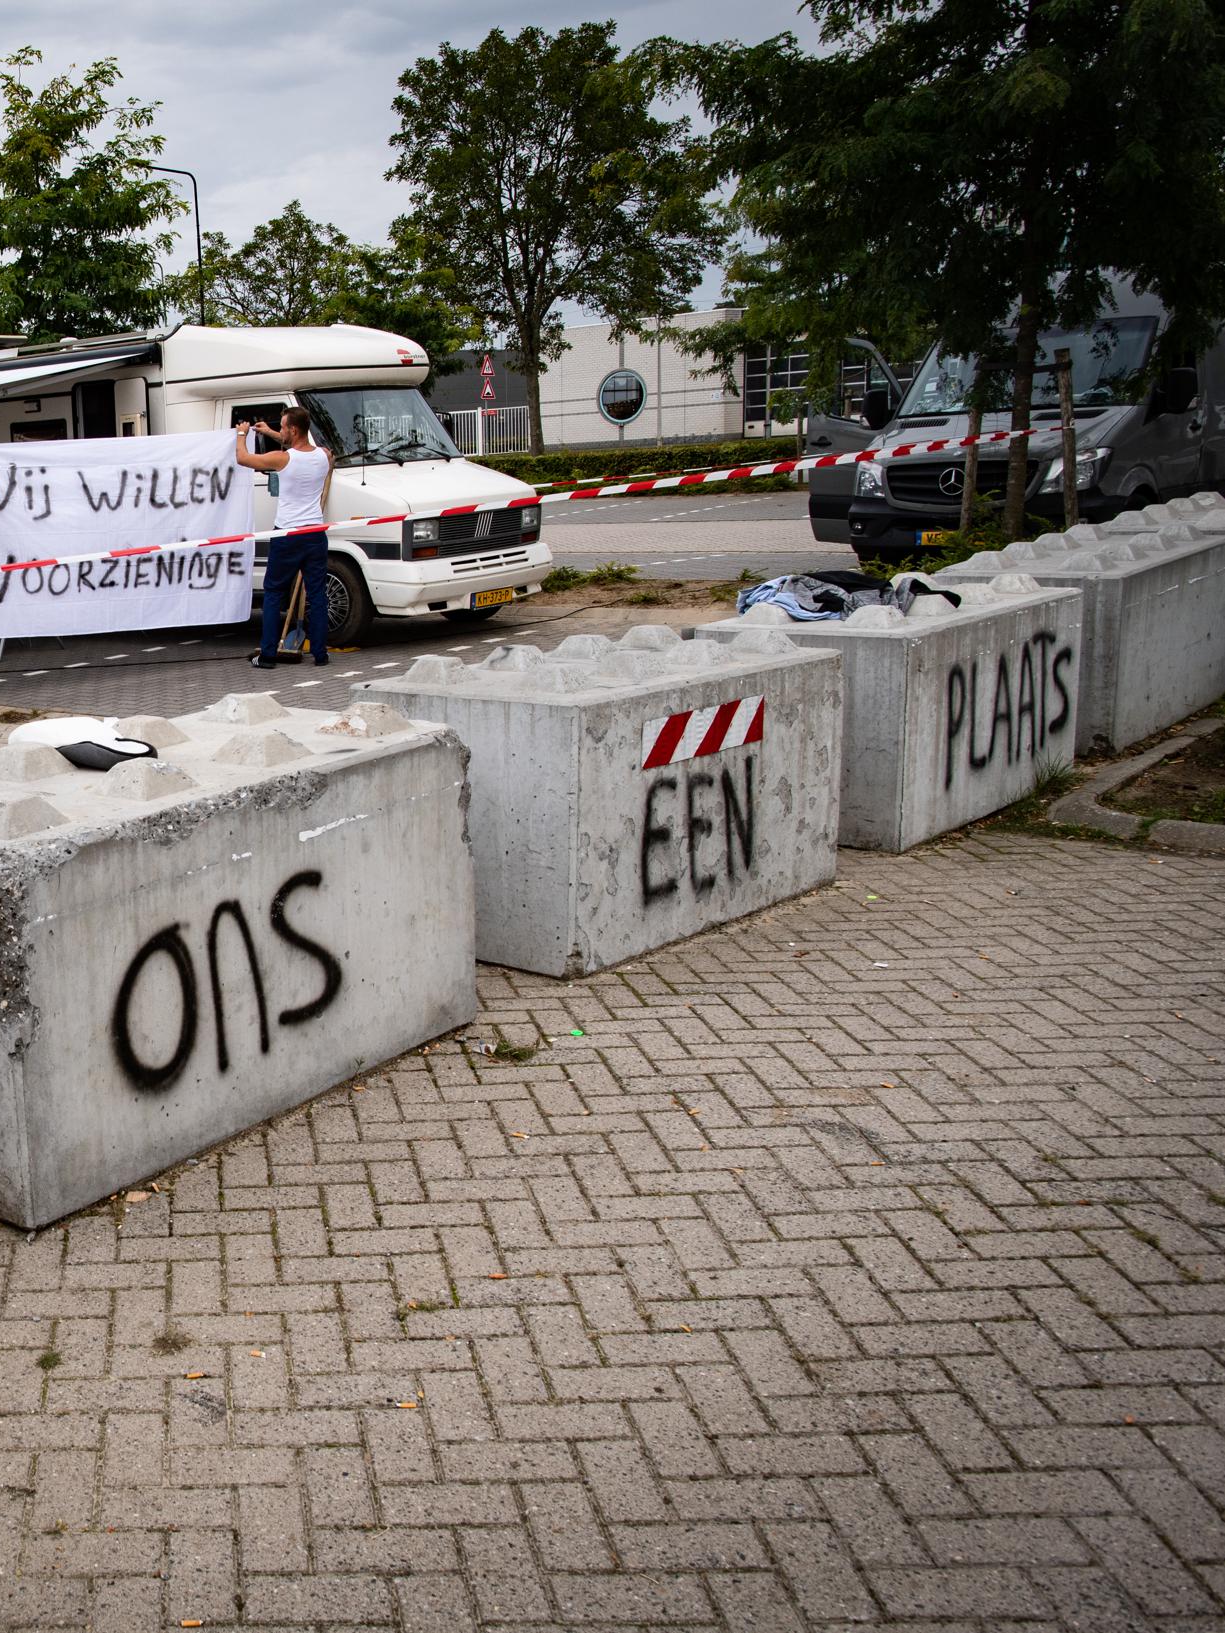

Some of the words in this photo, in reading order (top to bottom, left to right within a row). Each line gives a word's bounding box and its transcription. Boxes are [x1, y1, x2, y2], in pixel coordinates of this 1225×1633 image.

[477, 589, 510, 606] KH-373-P
[944, 629, 1072, 792] PLAATS
[640, 755, 753, 907] EEN
